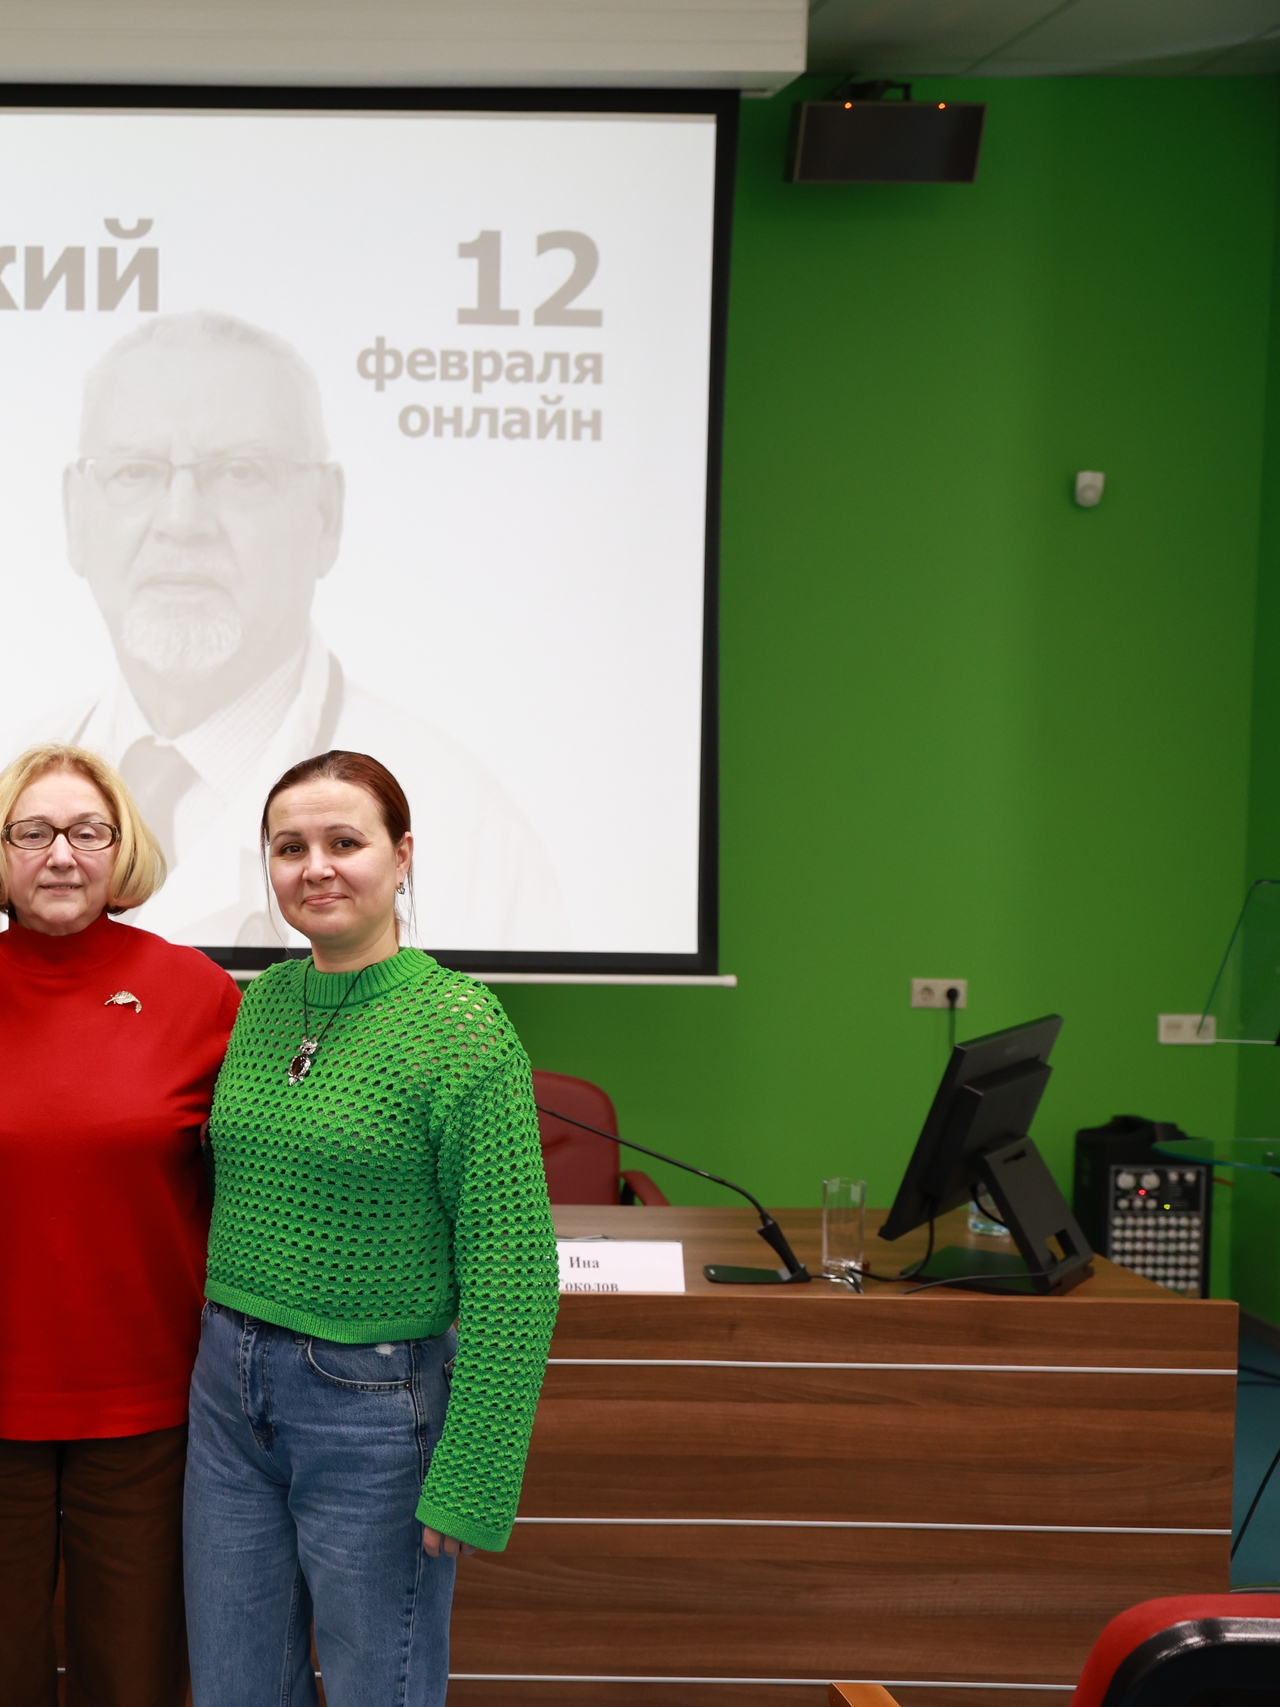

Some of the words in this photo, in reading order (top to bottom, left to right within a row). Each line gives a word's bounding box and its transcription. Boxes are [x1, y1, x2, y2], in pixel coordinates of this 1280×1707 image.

[457, 229, 603, 328] 12
[356, 335, 603, 394] февраля
[398, 394, 603, 441] онлайн
[559, 1279, 619, 1293] околов
[568, 1256, 600, 1269] Ина
